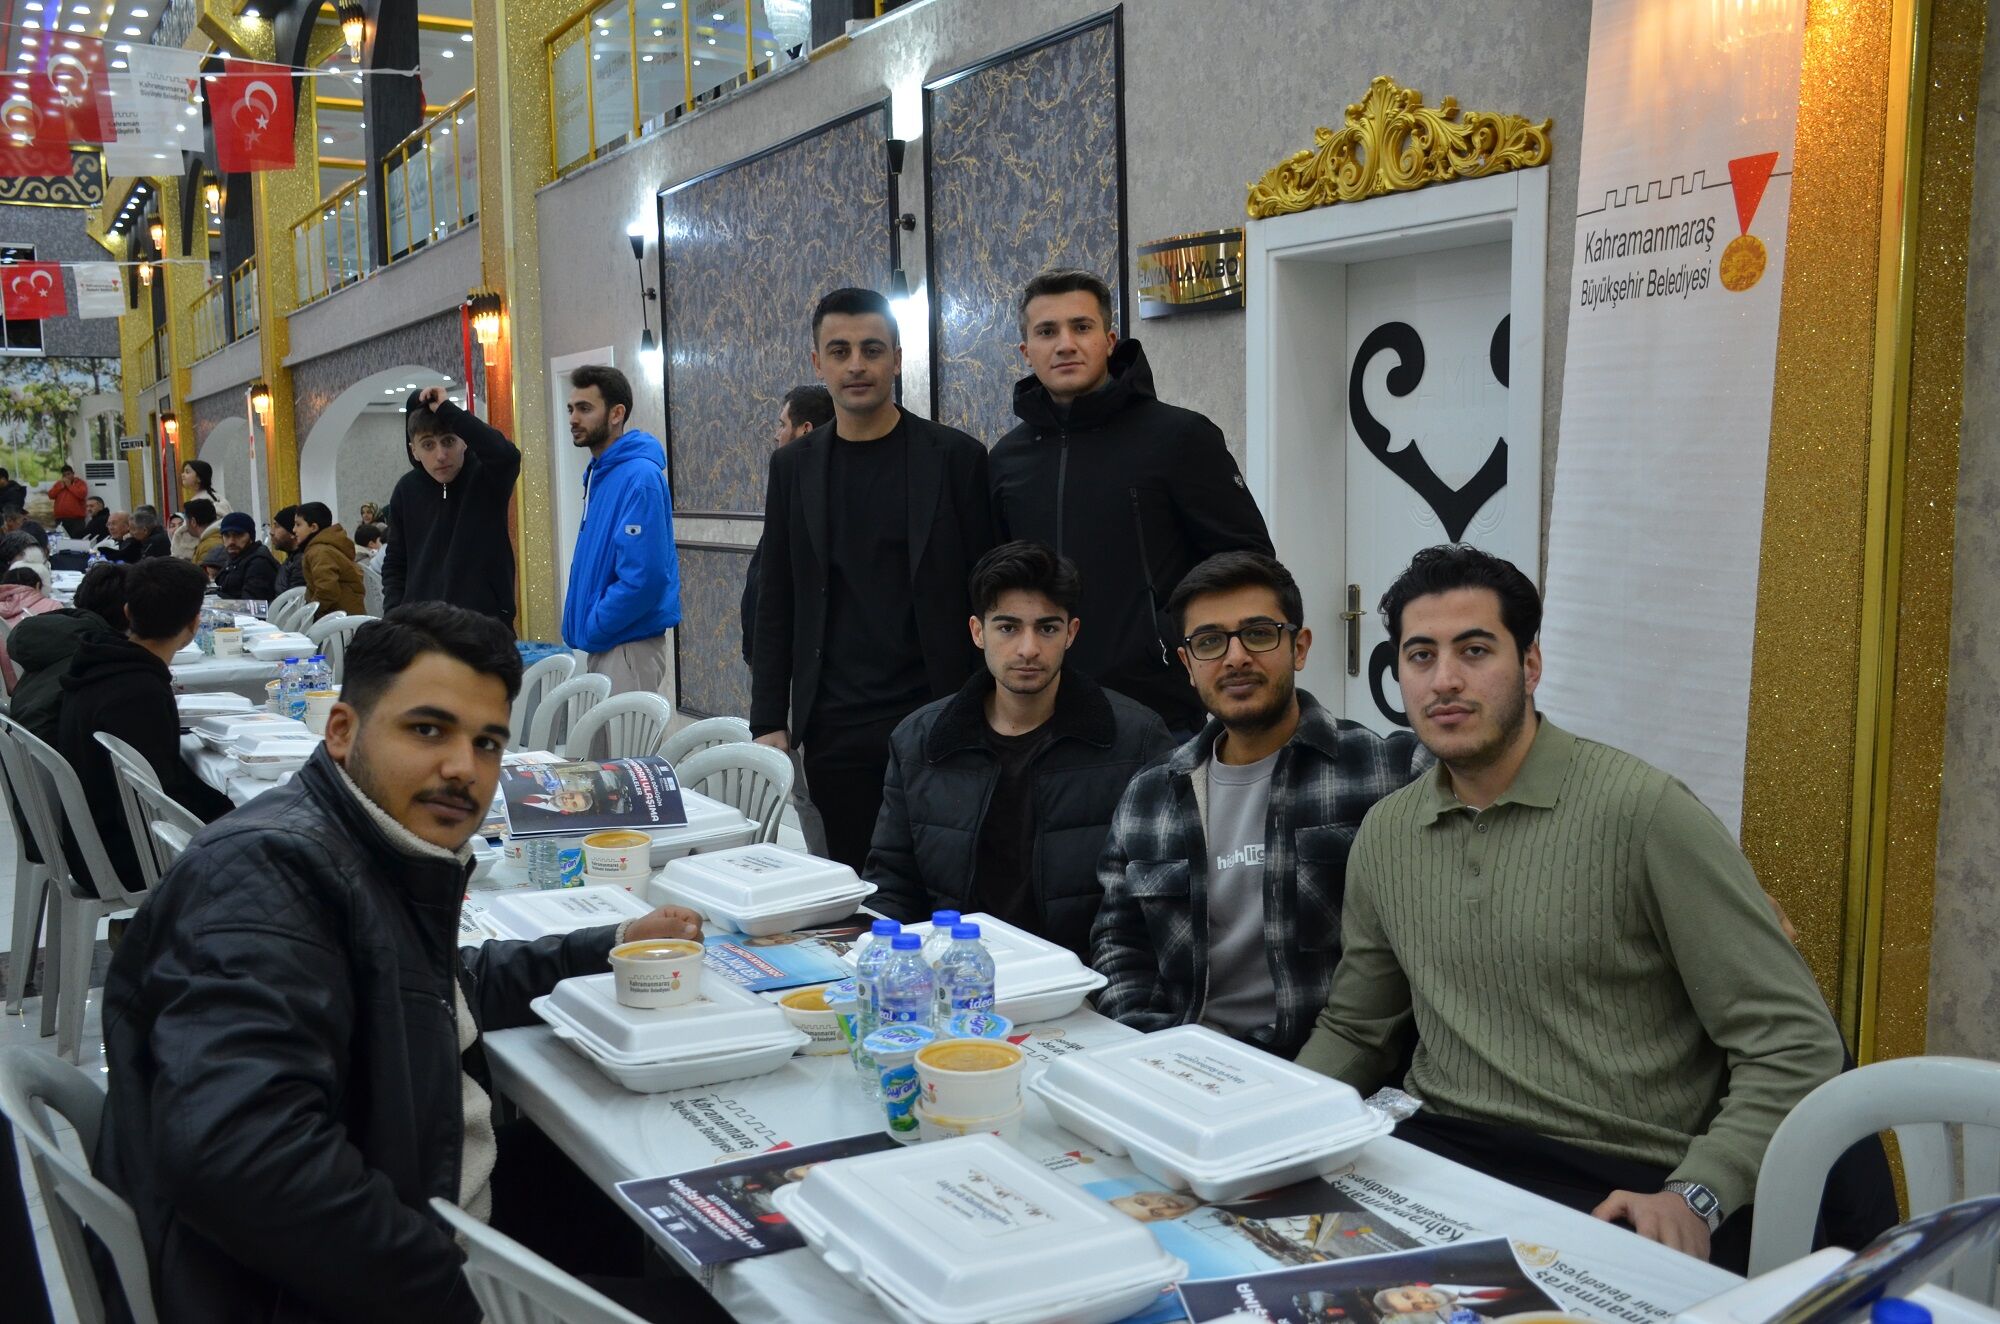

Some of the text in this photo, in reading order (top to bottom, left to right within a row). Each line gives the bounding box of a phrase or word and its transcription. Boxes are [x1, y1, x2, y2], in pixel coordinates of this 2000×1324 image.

[1584, 216, 1716, 264] Kahramanmaraş
[1176, 257, 1239, 282] LAVABO
[1580, 260, 1712, 312] Büyükşehir Belediyesi
[642, 782, 659, 822] ULAŞIMA
[1216, 846, 1265, 869] highlig
[689, 1097, 759, 1150] Kahramanmaraş
[667, 1178, 712, 1206] ULAŞIMA
[1343, 1172, 1409, 1206] Belediyesi
[702, 1205, 764, 1248] ALTYAPIDAN
[1331, 1179, 1465, 1243] Kahramanmaraş
[1547, 1260, 1632, 1302] Belediyesi
